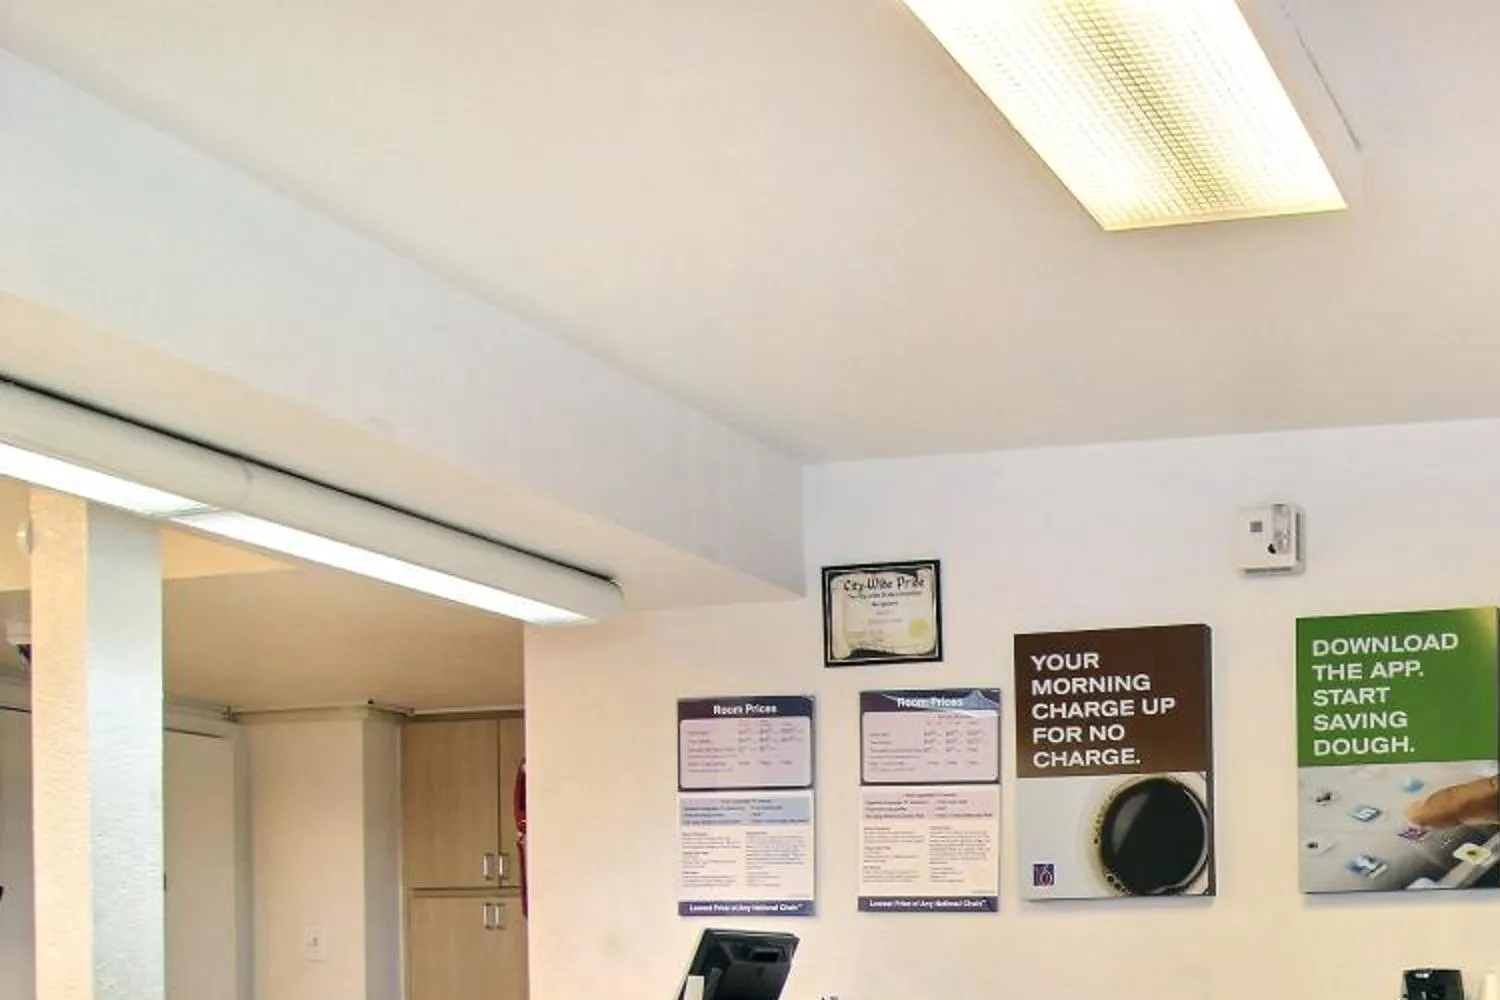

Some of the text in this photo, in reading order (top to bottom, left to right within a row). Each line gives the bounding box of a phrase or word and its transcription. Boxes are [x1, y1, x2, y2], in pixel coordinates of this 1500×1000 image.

[1312, 633, 1459, 657] DOWNLOAD
[1030, 652, 1100, 672] YOUR
[1312, 660, 1424, 682] THE APP.
[1031, 673, 1151, 696] MORNING
[1313, 687, 1391, 707] START
[713, 703, 778, 715] Room Prices
[1031, 697, 1176, 720] CHARGE UP
[1313, 711, 1408, 731] SAVING
[1032, 723, 1126, 744] FOR NO
[1313, 736, 1416, 757] DOUGH.
[1033, 748, 1141, 768] CHARGE.
